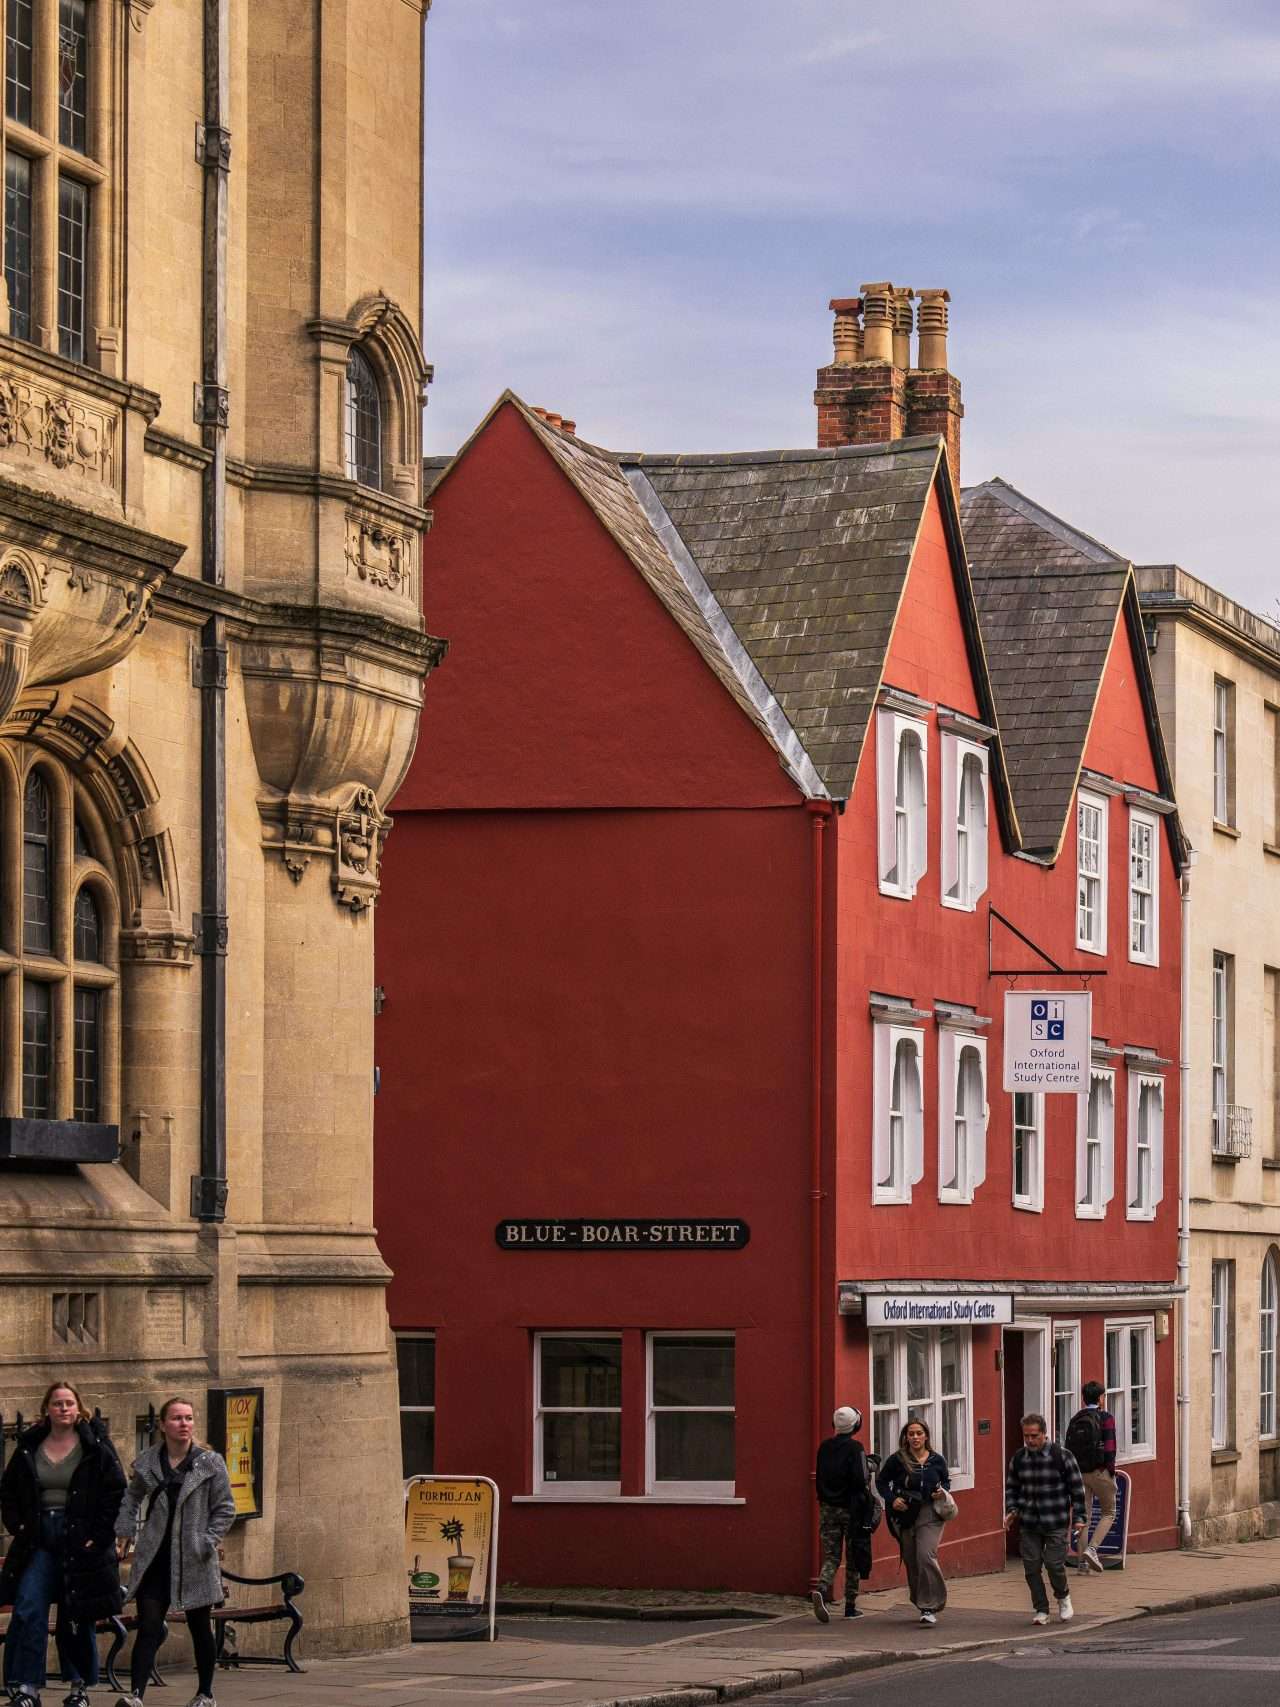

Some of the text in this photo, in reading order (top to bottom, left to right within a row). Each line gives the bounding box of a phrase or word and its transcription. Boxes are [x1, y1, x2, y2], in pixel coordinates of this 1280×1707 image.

[1030, 1048, 1065, 1058] Oxford
[1014, 1061, 1080, 1070] International
[1014, 1072, 1080, 1083] Study Centre
[883, 1300, 995, 1322] Oxford International Study Centre
